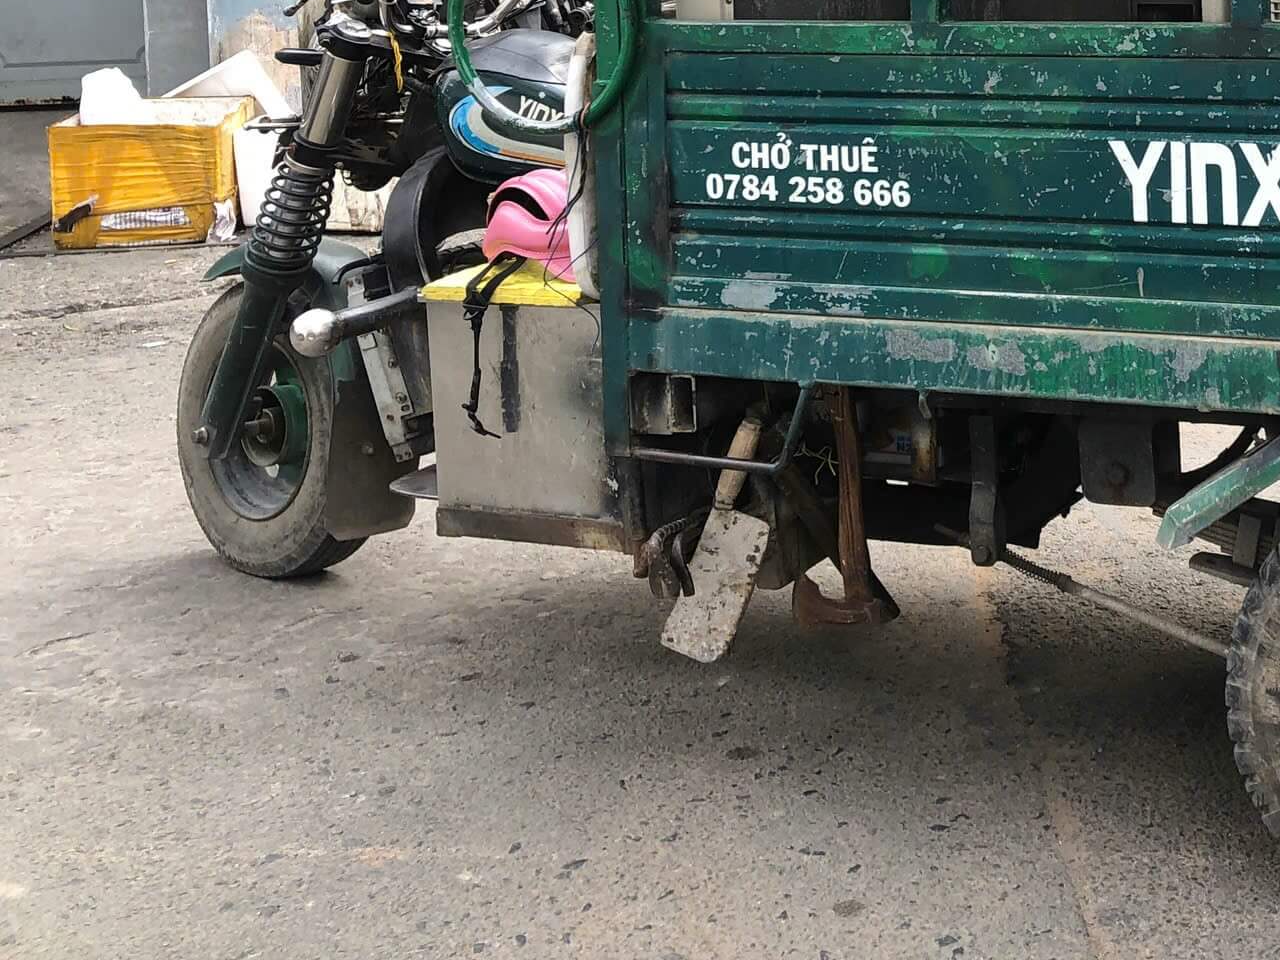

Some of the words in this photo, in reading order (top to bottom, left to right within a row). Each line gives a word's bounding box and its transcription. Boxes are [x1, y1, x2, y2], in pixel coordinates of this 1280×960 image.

[731, 132, 792, 170] CHỞ
[799, 137, 879, 173] THUÊ
[705, 173, 779, 202] 0784
[788, 176, 845, 204] 258
[853, 178, 911, 208] 666
